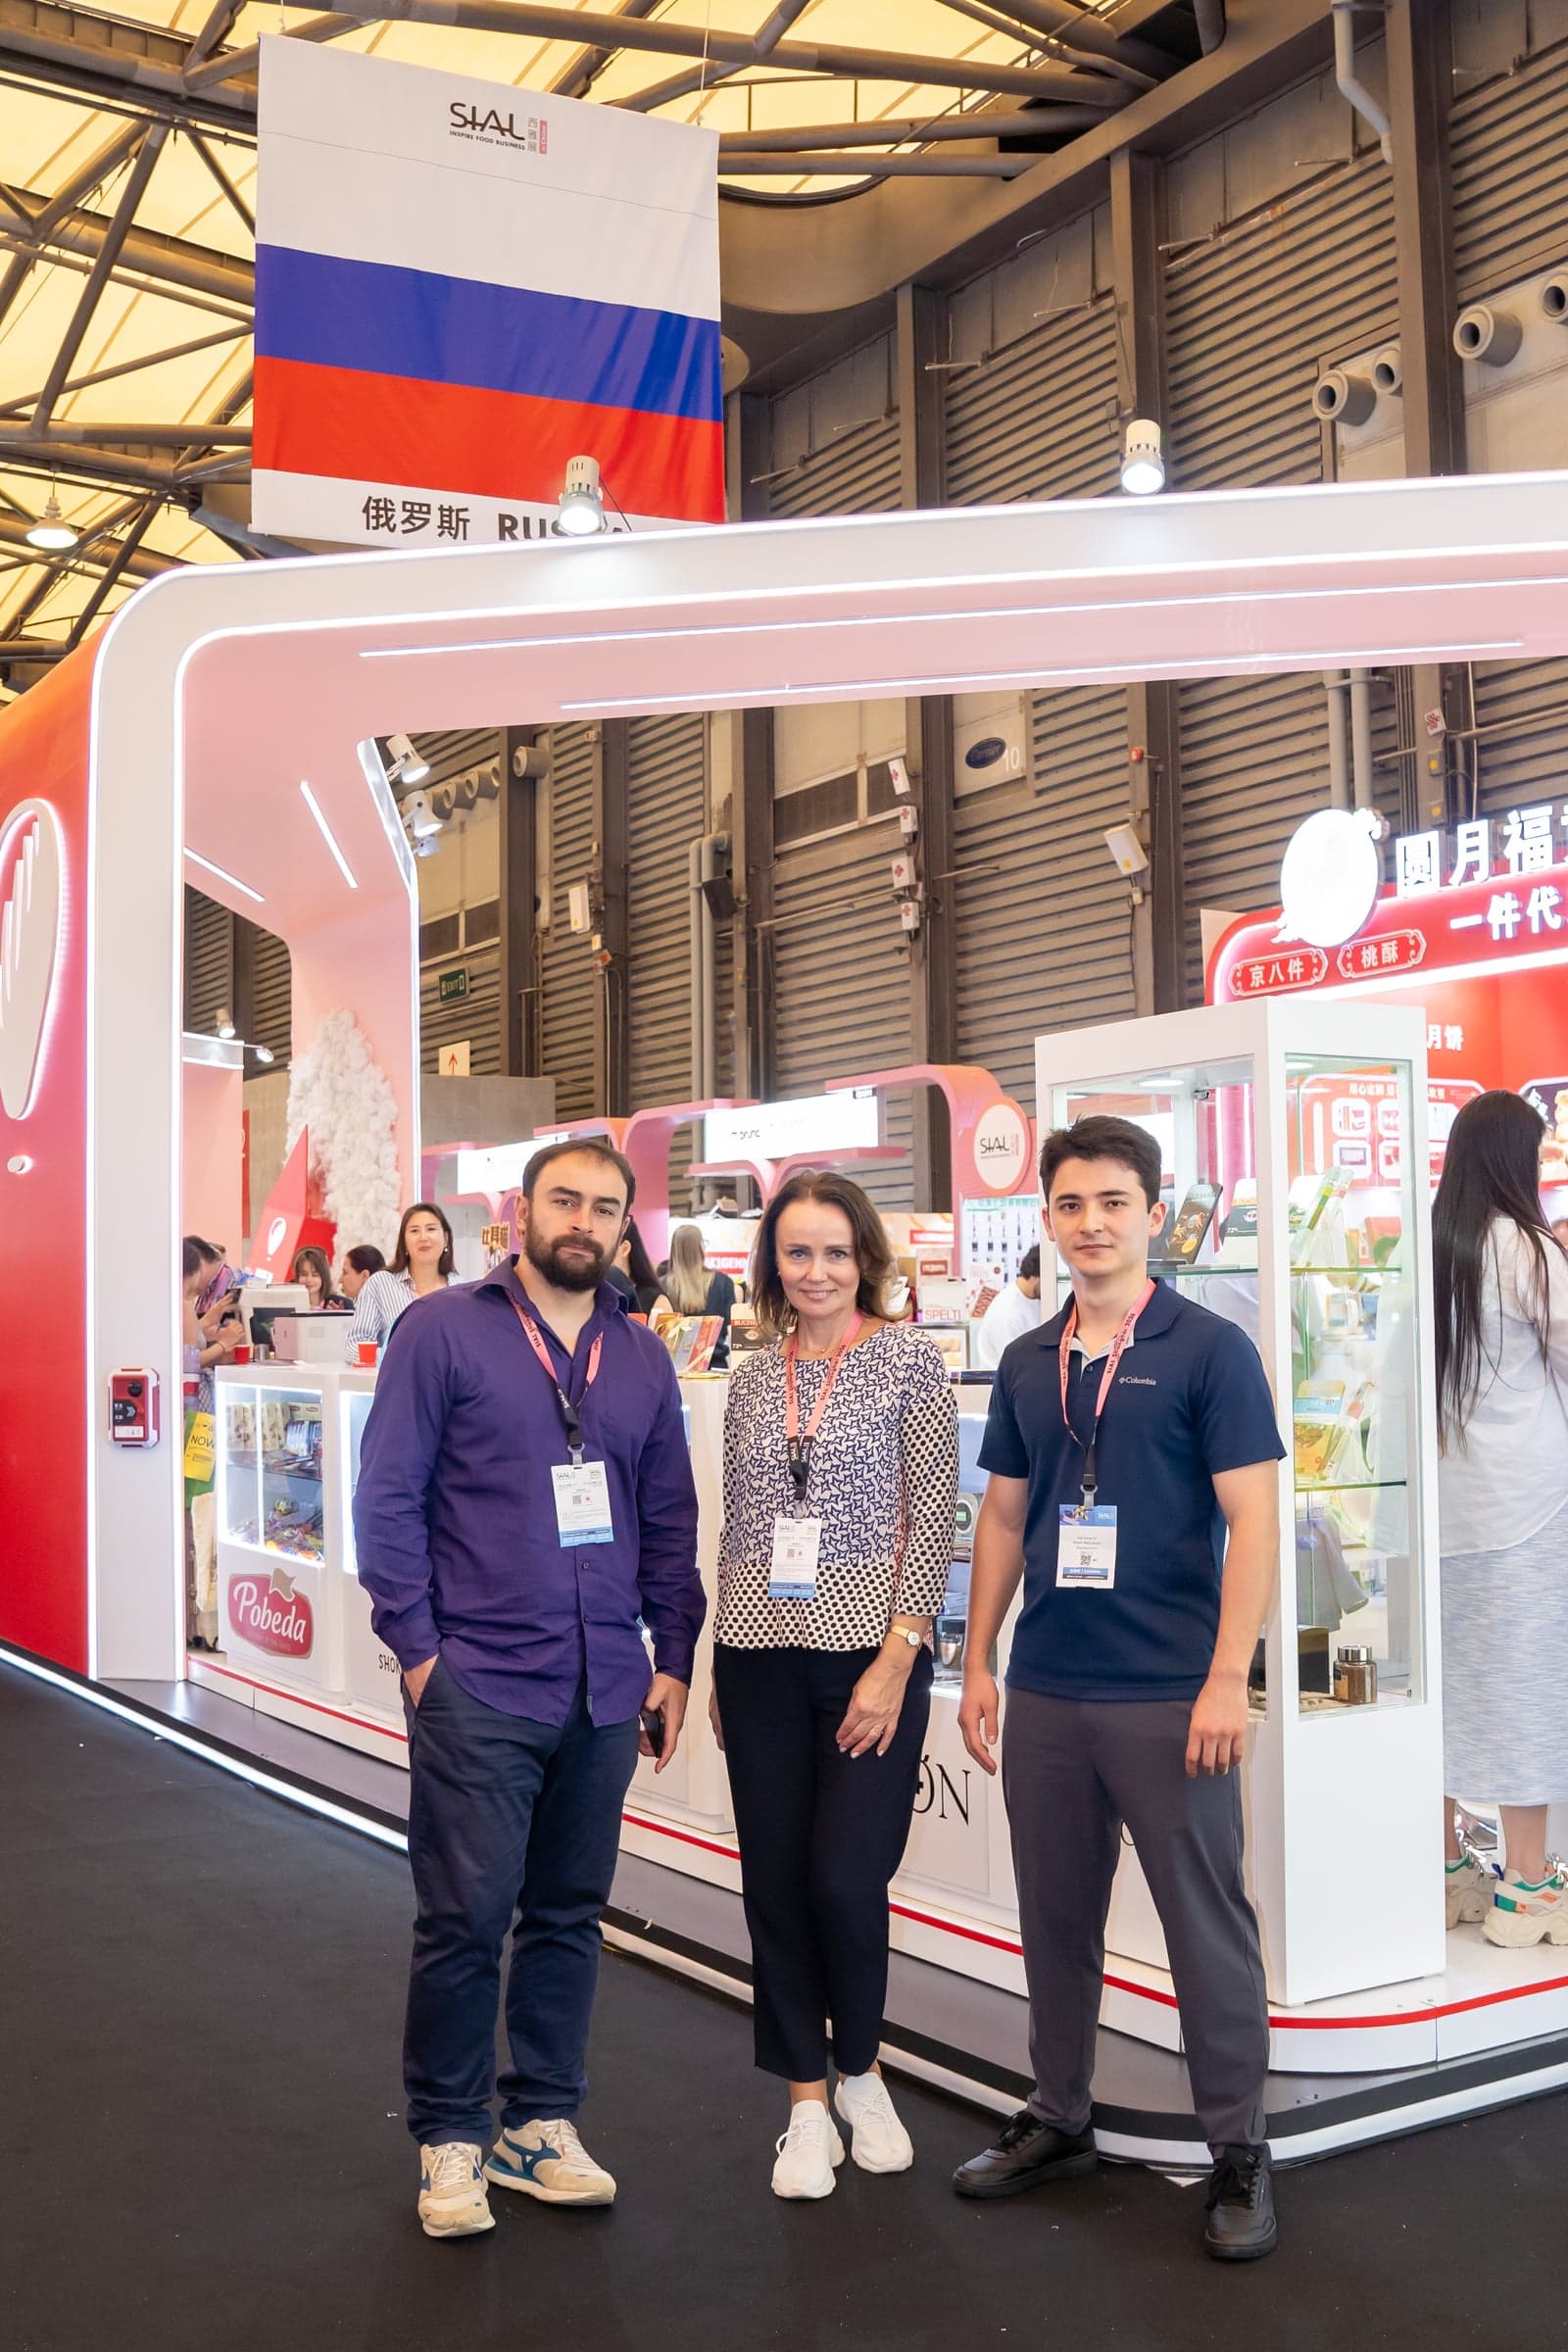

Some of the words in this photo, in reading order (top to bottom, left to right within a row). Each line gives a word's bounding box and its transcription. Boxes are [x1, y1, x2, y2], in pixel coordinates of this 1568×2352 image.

[450, 102, 526, 141] SIAL
[449, 129, 473, 140] INSPIRE
[495, 139, 526, 151] BUSINESS
[362, 495, 470, 541] 俄罗斯
[1003, 746, 1020, 772] 10
[1395, 804, 1568, 899] 圆月福
[1360, 940, 1399, 968] 桃酥
[1249, 956, 1305, 989] 京八件
[980, 1134, 1010, 1154] SIAL
[1125, 1376, 1156, 1386] Columbia
[233, 1581, 307, 1643] Pobeda
